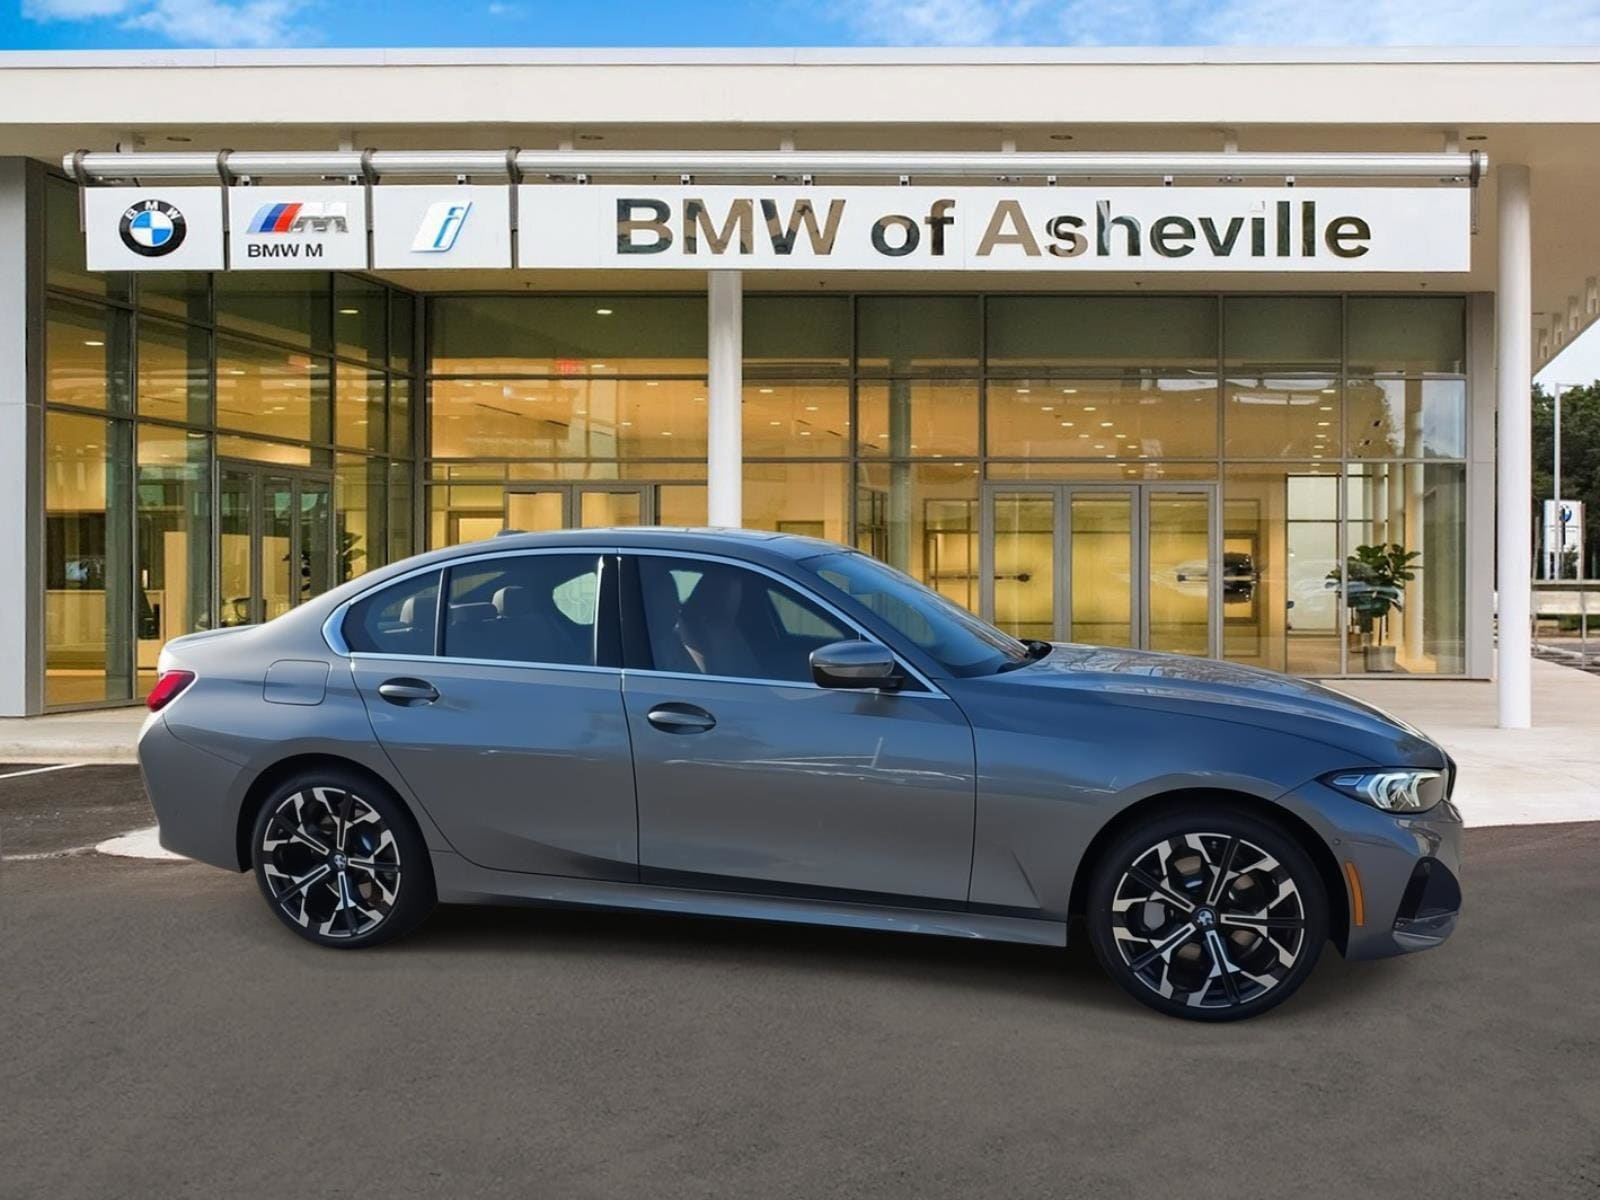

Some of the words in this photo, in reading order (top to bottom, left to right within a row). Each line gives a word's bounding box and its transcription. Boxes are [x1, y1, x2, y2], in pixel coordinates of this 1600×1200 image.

[125, 200, 181, 220] BMW
[617, 198, 846, 255] BMW
[871, 199, 955, 257] of
[975, 199, 1371, 258] Asheville
[247, 243, 300, 258] BMW
[305, 243, 323, 258] M
